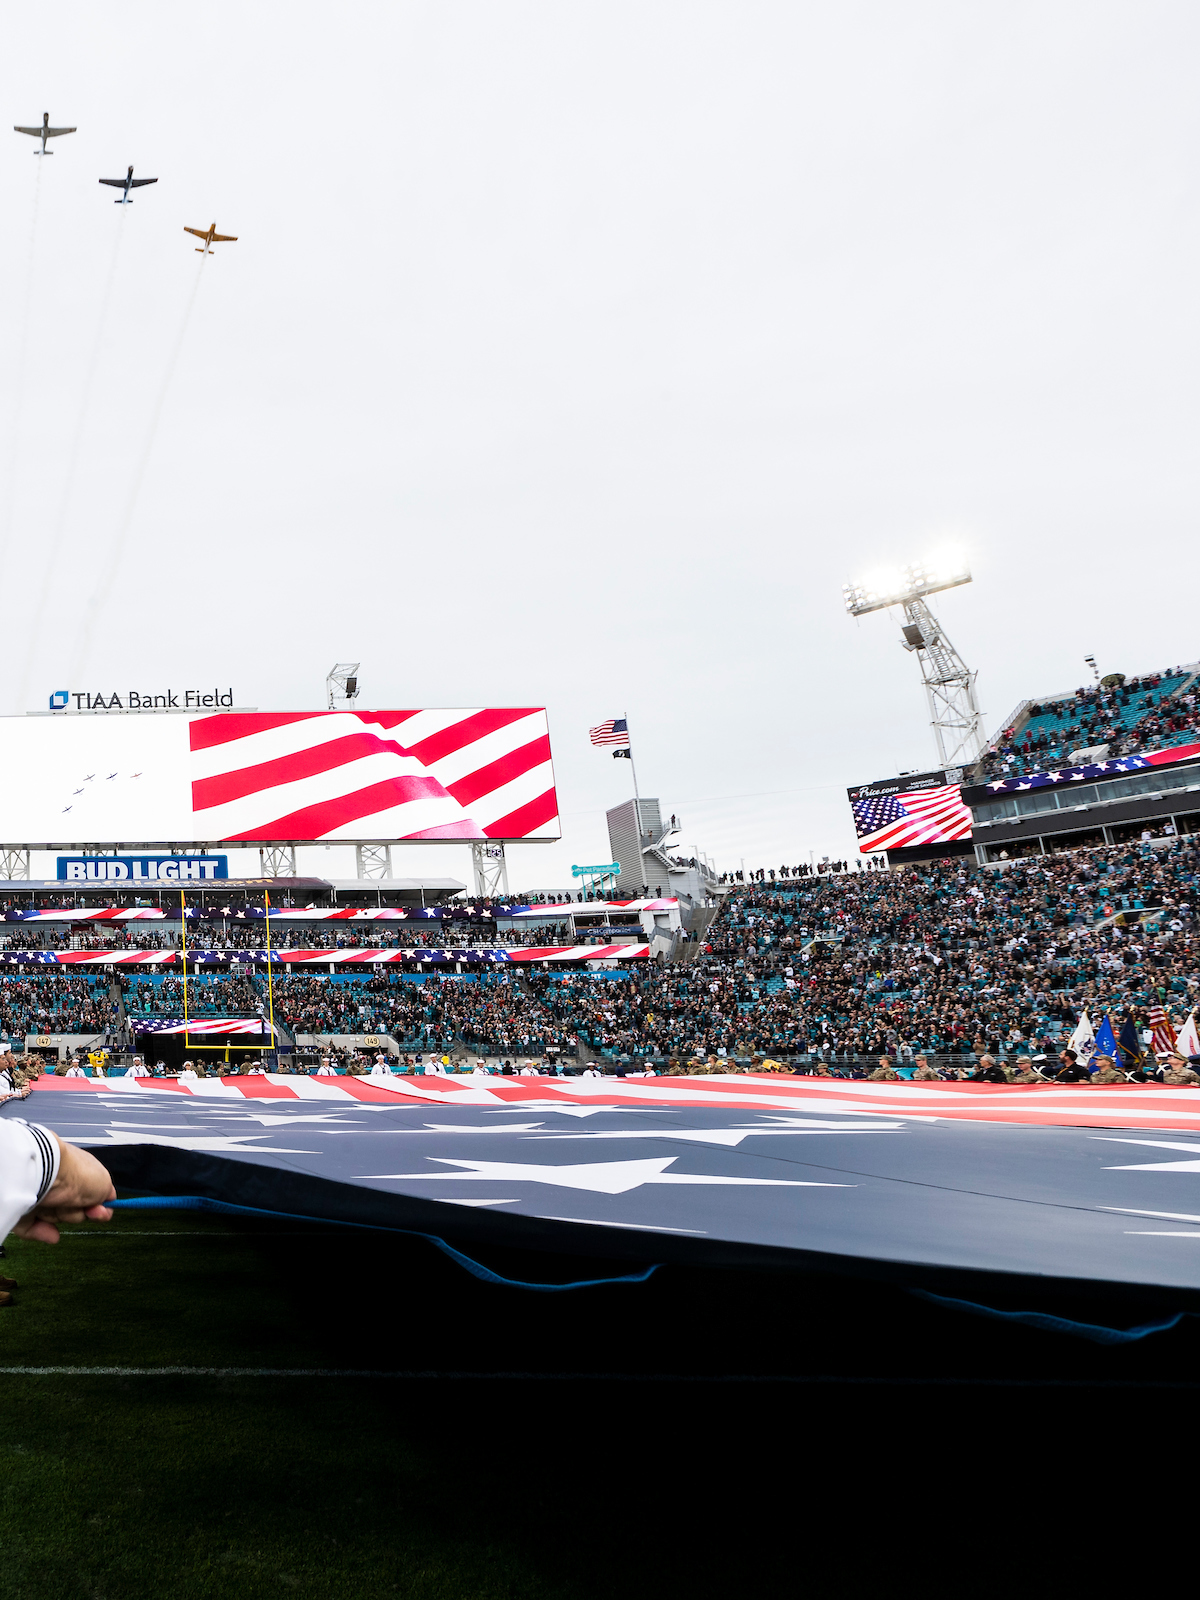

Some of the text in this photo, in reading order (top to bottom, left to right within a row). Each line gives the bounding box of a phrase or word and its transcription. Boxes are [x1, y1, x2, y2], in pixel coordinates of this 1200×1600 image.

[72, 688, 233, 709] TIAA Bank Field
[859, 786, 900, 797] Price.com
[67, 861, 218, 879] BUD LIGHT
